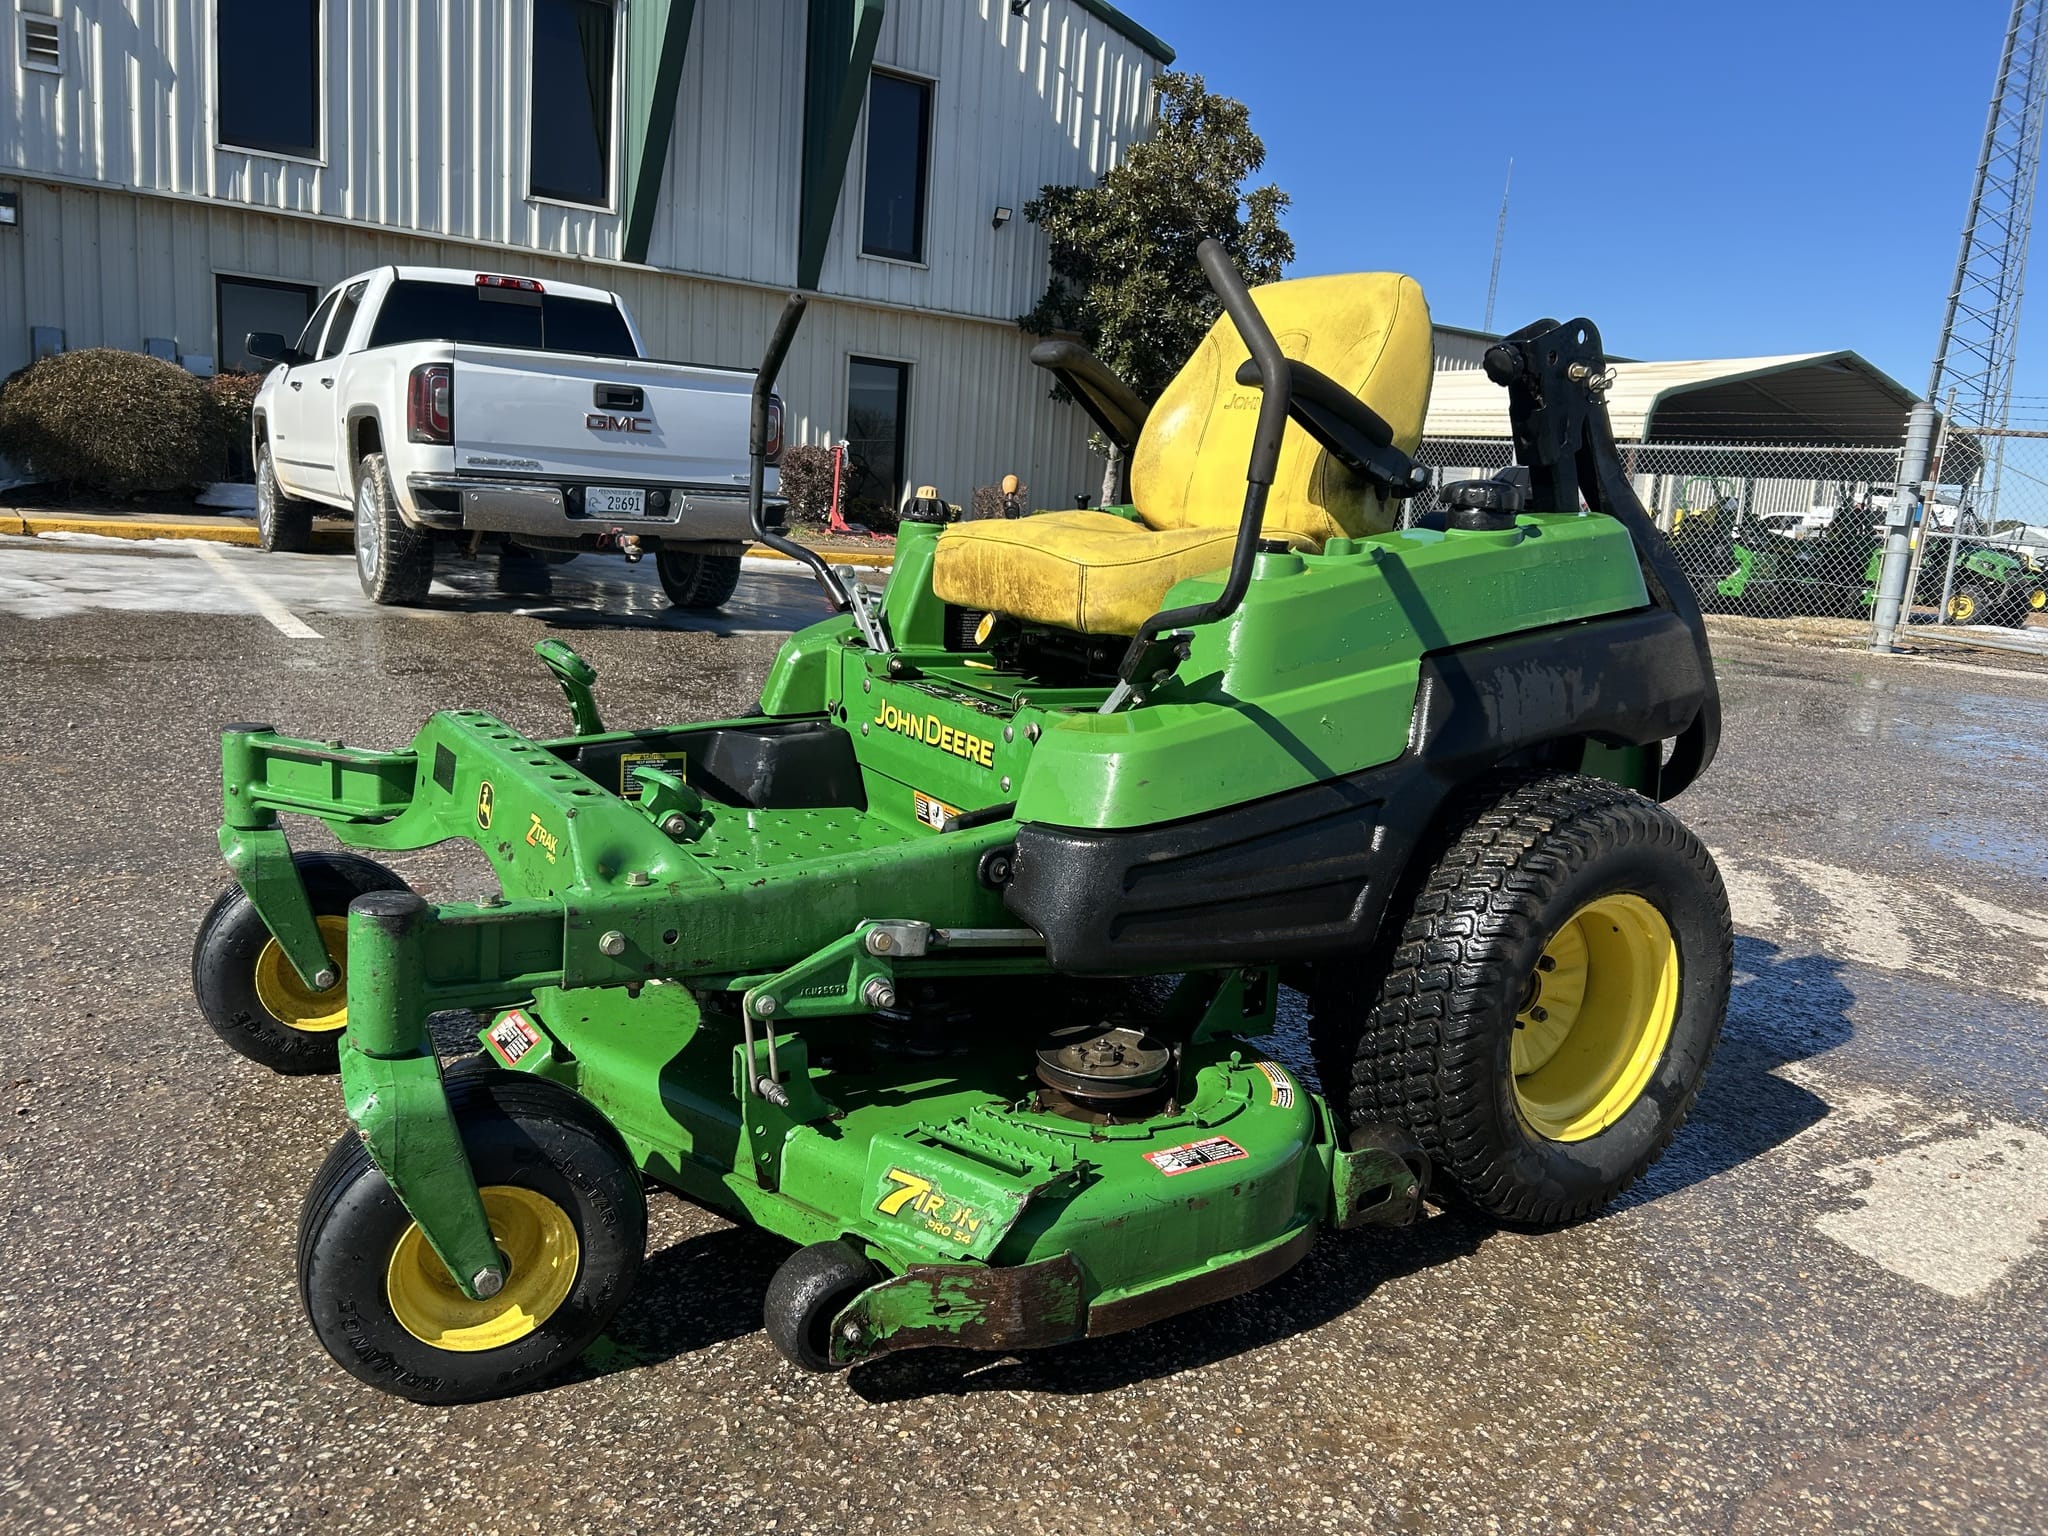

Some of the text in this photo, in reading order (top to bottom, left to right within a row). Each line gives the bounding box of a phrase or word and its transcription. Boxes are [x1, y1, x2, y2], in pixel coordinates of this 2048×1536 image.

[584, 413, 651, 433] GMC
[874, 698, 994, 769] JOHN DEERE
[925, 1218, 971, 1245] PRO 54
